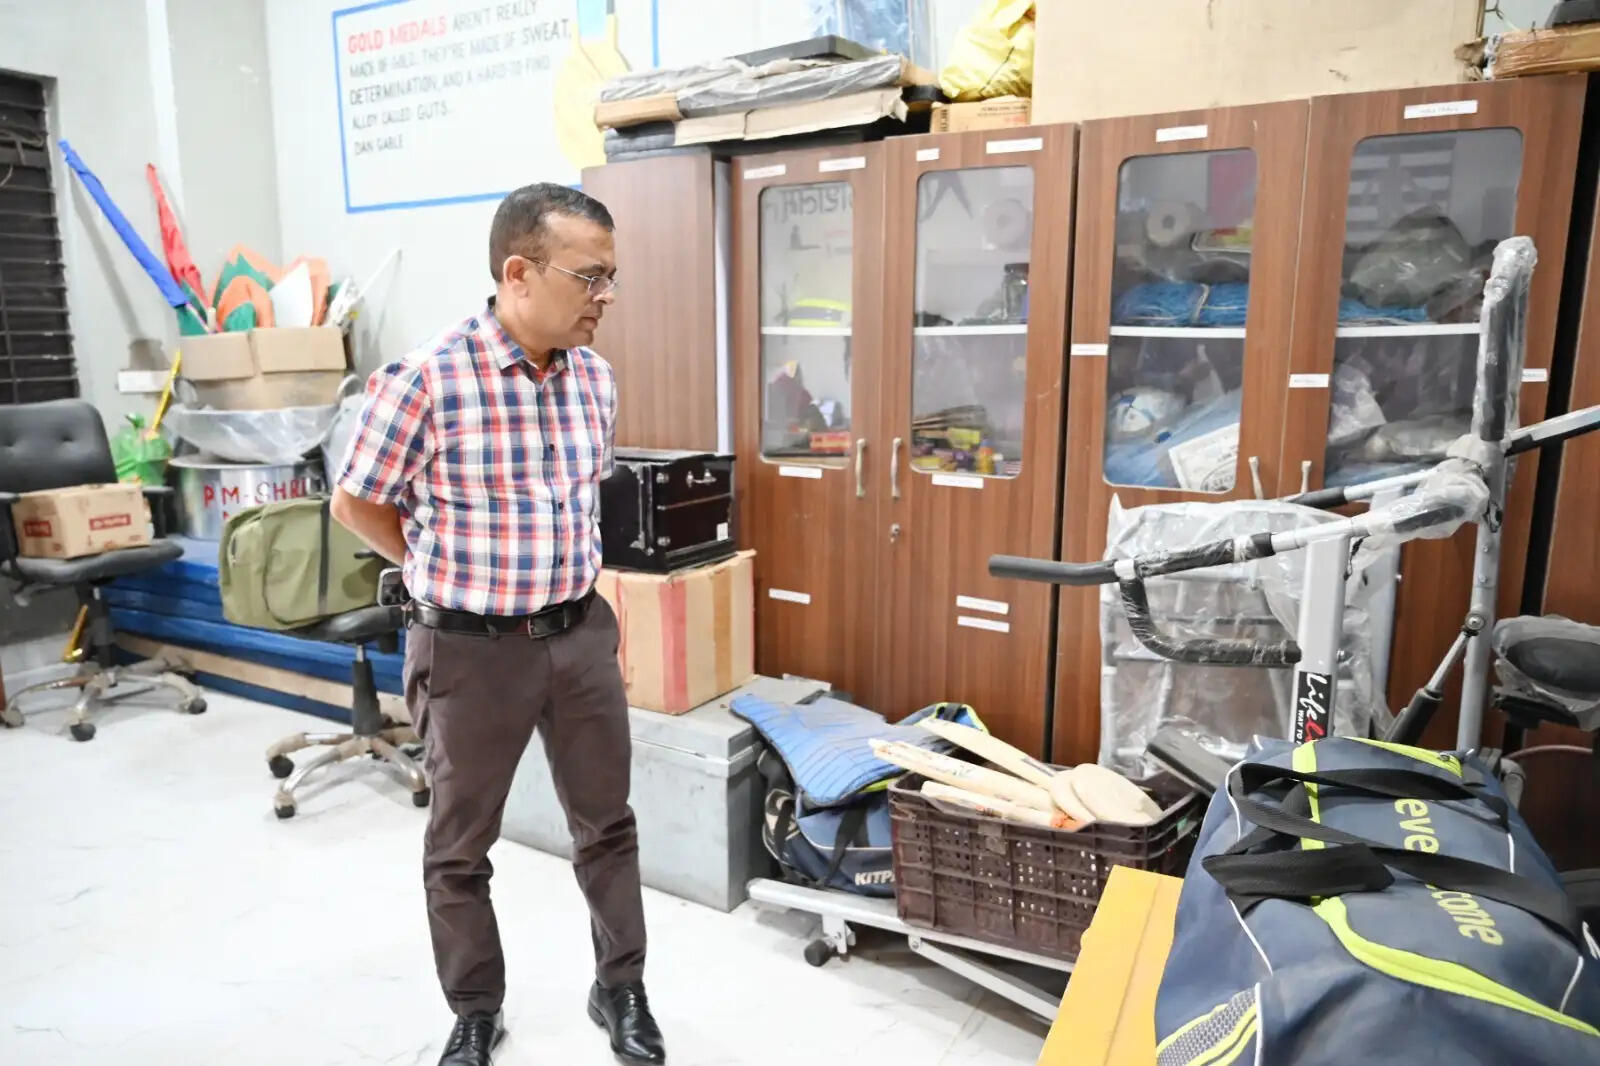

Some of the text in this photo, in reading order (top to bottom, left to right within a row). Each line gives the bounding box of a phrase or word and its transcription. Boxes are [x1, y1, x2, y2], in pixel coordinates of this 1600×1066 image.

[348, 29, 383, 54] GOLD
[390, 15, 447, 45] MEDALS
[496, 0, 537, 22] REALLY
[469, 34, 500, 55] MADE
[443, 71, 463, 88] AND
[355, 140, 374, 155] DAN
[1299, 672, 1328, 743] Lifel
[1297, 710, 1305, 731] WAY
[1296, 729, 1303, 740] TO
[1394, 798, 1440, 854] eve
[1425, 884, 1504, 946] come
